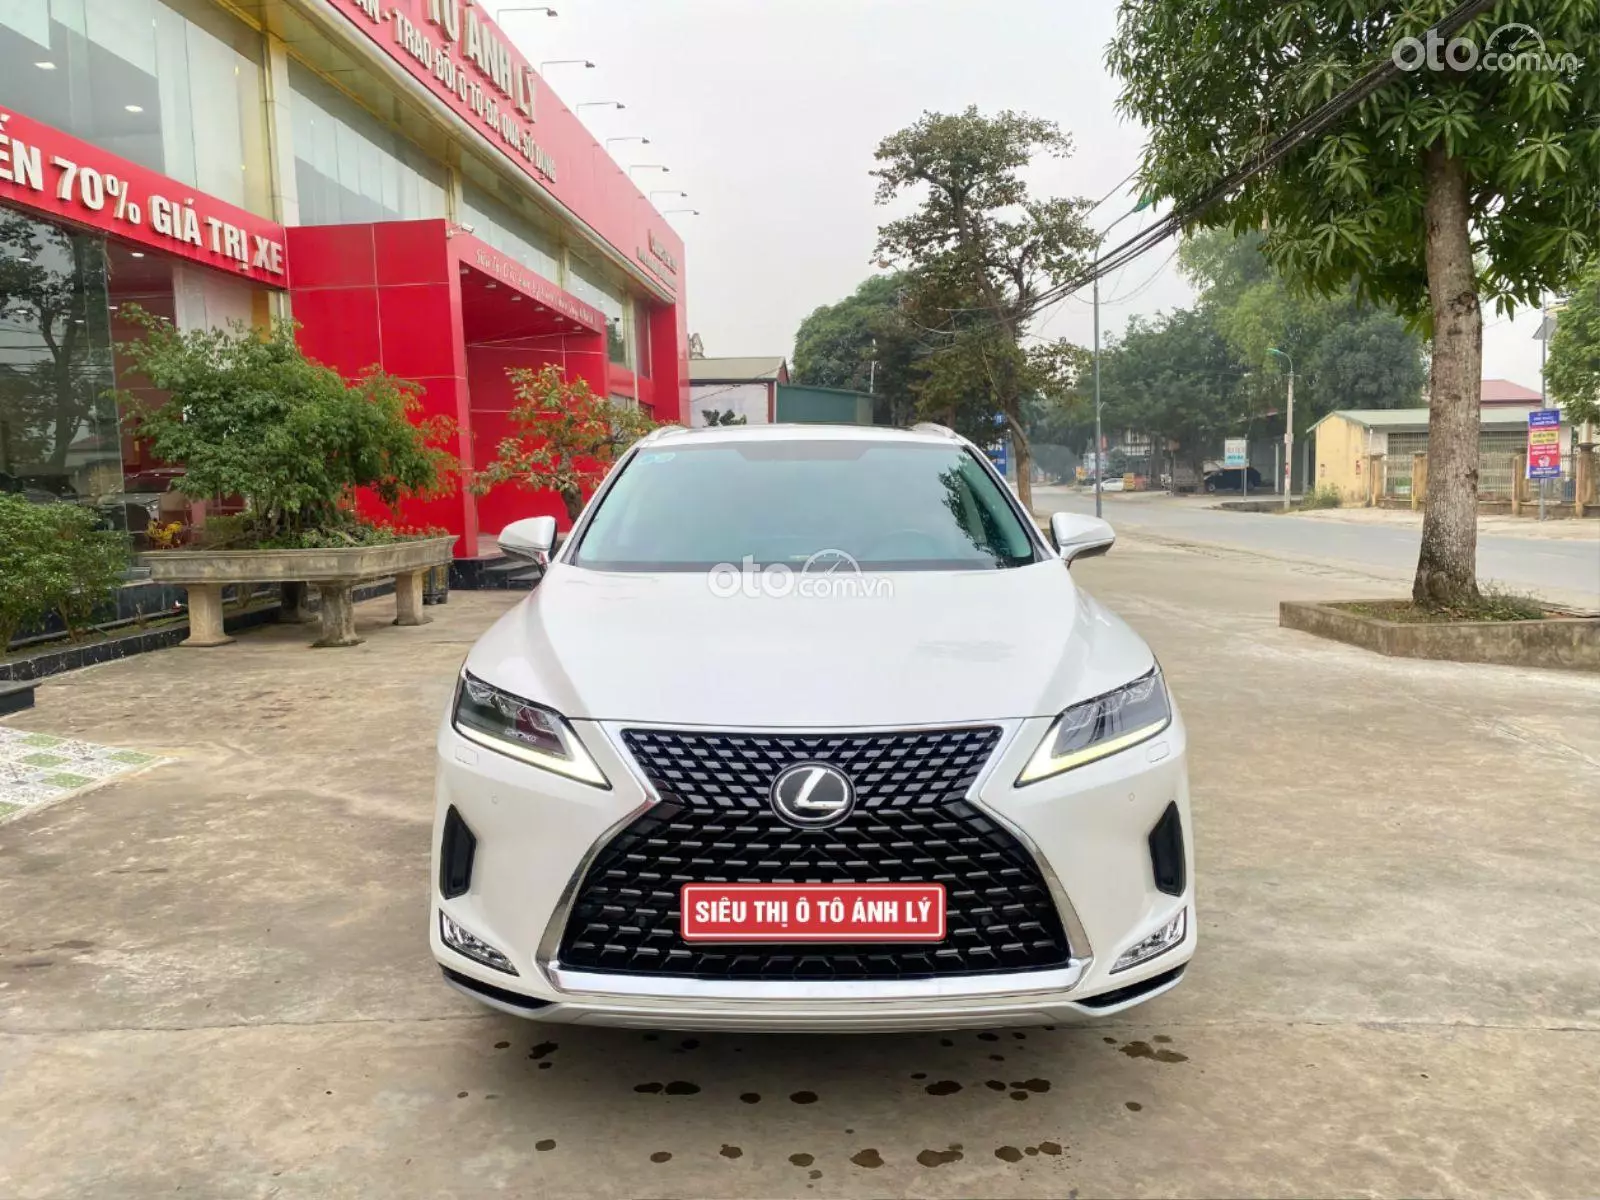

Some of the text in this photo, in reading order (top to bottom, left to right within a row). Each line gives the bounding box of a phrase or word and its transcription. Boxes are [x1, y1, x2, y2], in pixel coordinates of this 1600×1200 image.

[393, 7, 431, 69] TRAO
[501, 113, 521, 153] QUA
[51, 156, 141, 225] 70%
[149, 195, 203, 247] GIÁ
[204, 215, 249, 271] TRỊ
[251, 234, 284, 275] XE
[695, 896, 932, 928] SIÊU THỊ Ô TÔ ÁNH LÝ
